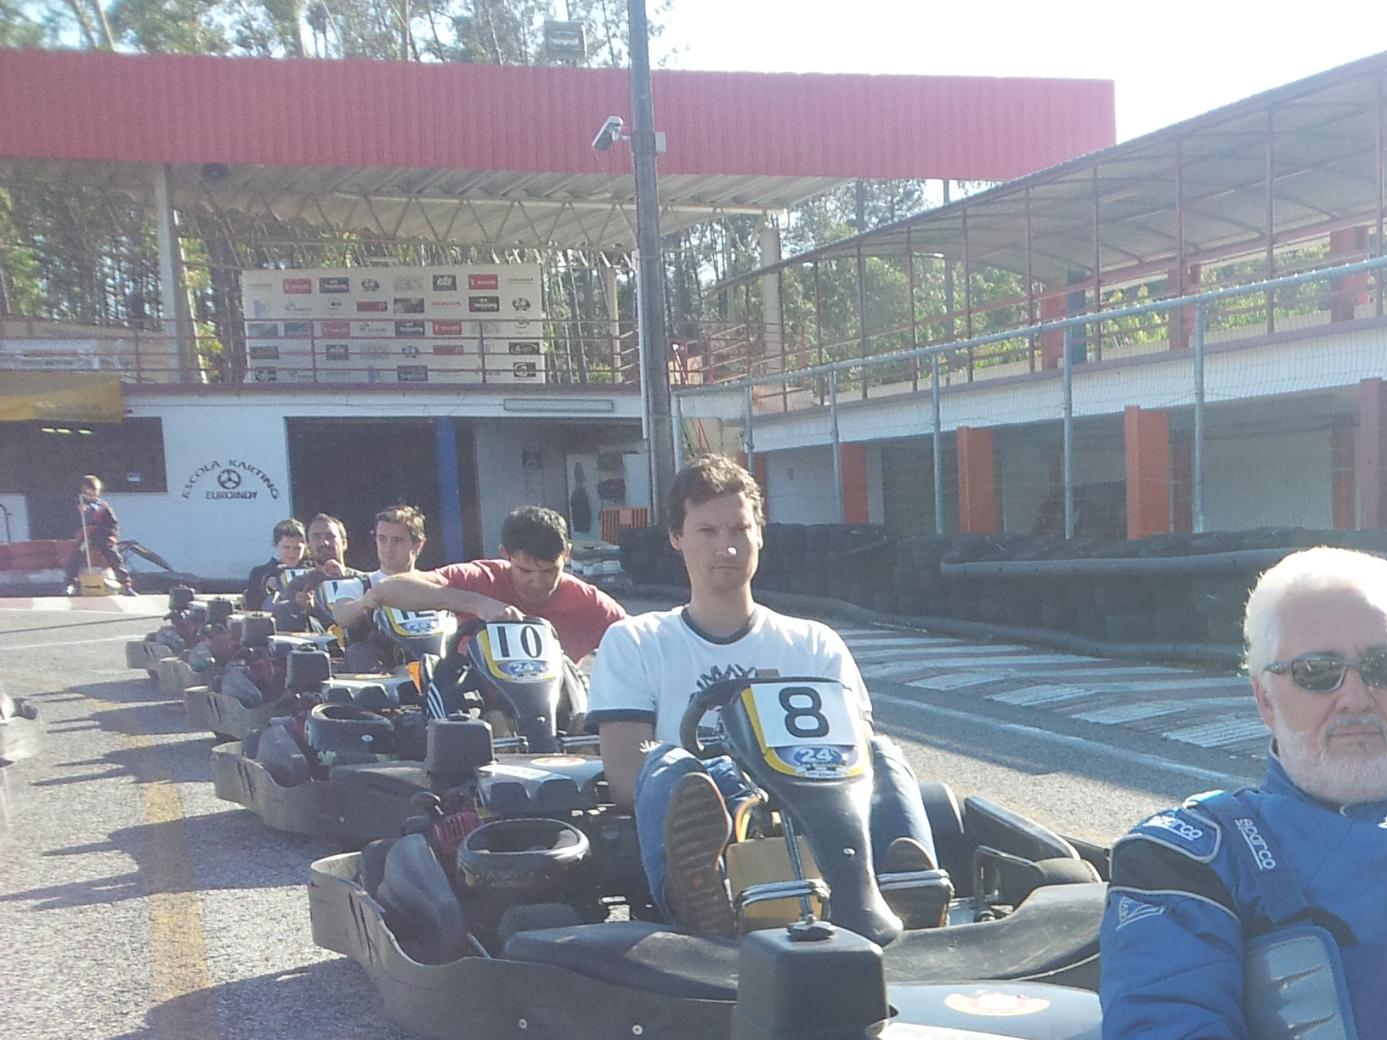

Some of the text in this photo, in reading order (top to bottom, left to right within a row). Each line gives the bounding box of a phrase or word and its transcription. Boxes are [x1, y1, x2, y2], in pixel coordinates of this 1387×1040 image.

[182, 459, 279, 500] ESCOLA KARTING
[205, 490, 258, 500] EUROINDY
[497, 625, 543, 658] 10
[778, 686, 830, 738] 8
[800, 749, 832, 763] 24
